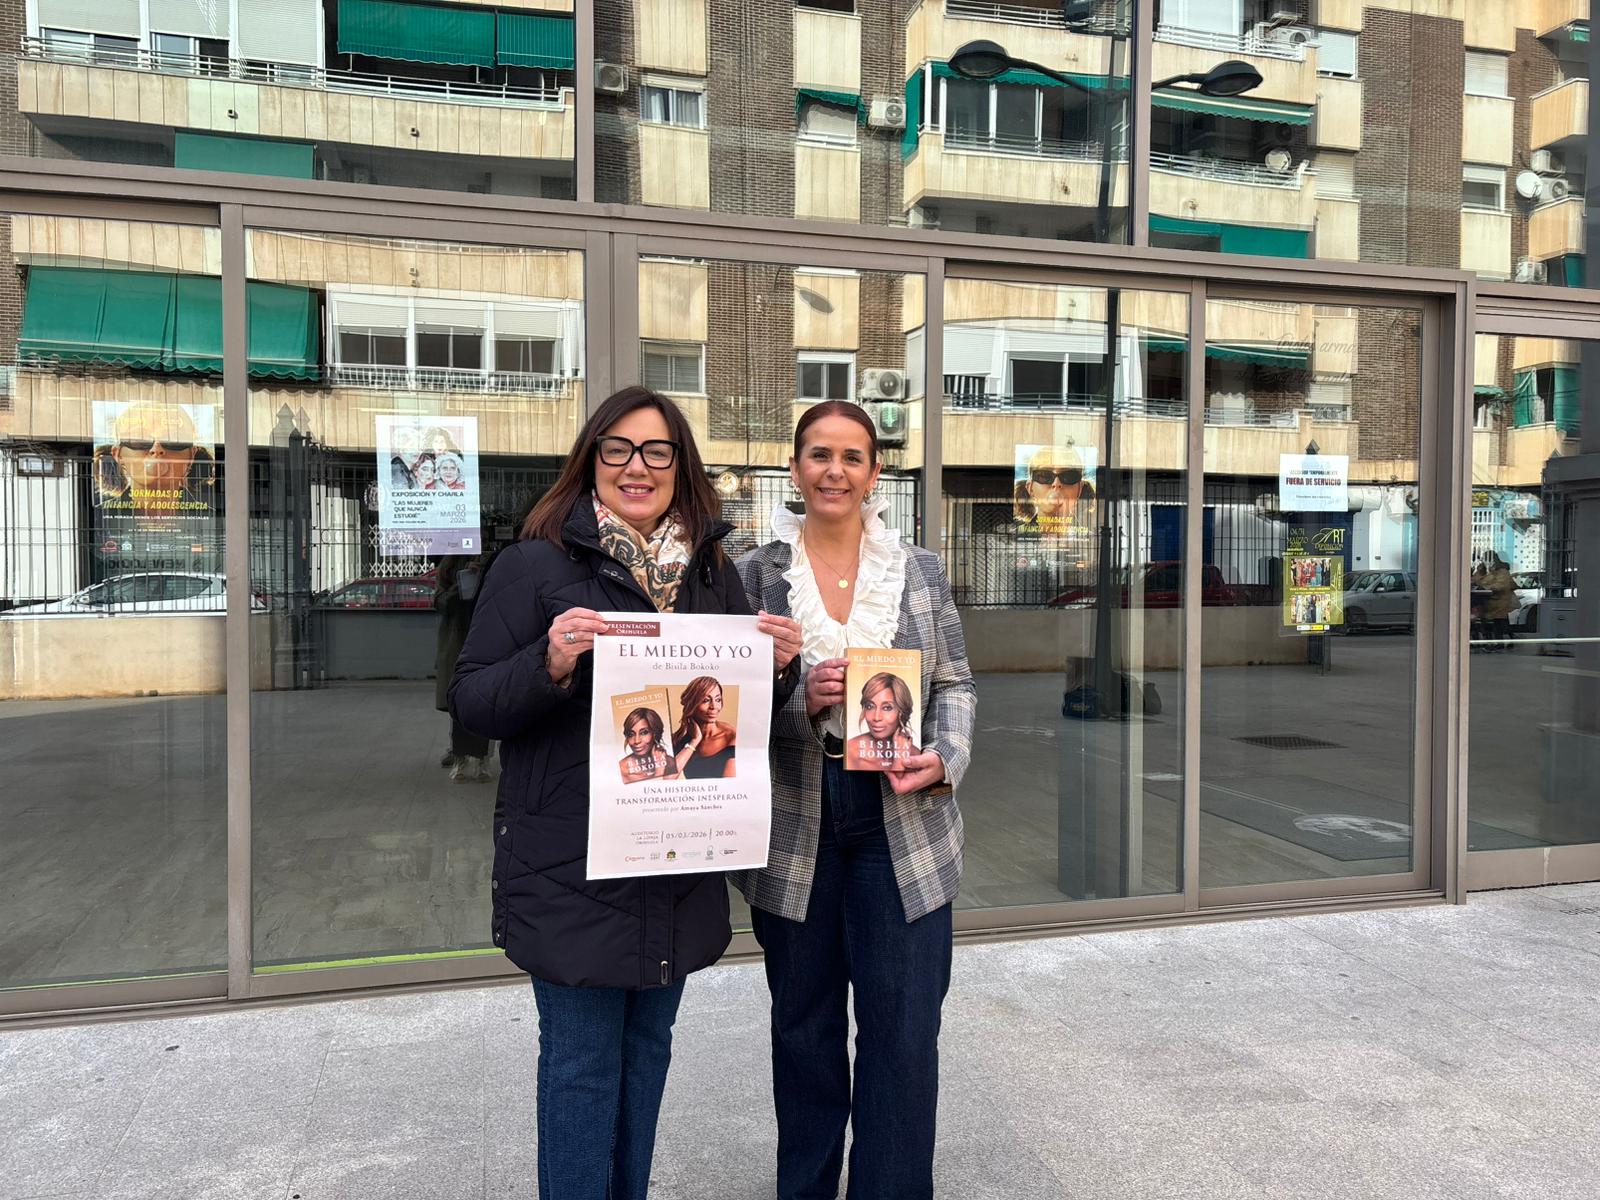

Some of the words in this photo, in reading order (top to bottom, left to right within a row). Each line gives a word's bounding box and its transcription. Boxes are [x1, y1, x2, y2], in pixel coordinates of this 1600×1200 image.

[1286, 477, 1304, 485] FUERA
[1306, 477, 1312, 485] DE
[1314, 477, 1341, 486] SERVICIO
[128, 489, 172, 498] JORNADAS
[173, 489, 184, 498] DE
[103, 500, 142, 510] INFANCIA
[144, 501, 149, 509] Y
[150, 501, 209, 510] ADOLESCENCIA
[608, 622, 656, 630] PRESENTACIÓN
[619, 643, 639, 657] EL
[644, 644, 707, 658] MIEDO
[712, 645, 722, 658] Y
[729, 645, 752, 659] YO
[853, 655, 865, 663] EL
[866, 655, 896, 663] MIEDO
[905, 656, 915, 664] YO
[652, 662, 663, 670] de
[665, 662, 687, 670] Bisila
[690, 662, 719, 671] Bokoko
[860, 740, 910, 750] BISILA
[860, 749, 911, 759] BOKOKO
[643, 786, 662, 794] UNA
[664, 785, 706, 794] HISTORIA
[616, 795, 695, 805] TRANSFORMACIÓN
[697, 794, 748, 802] INESPERADA
